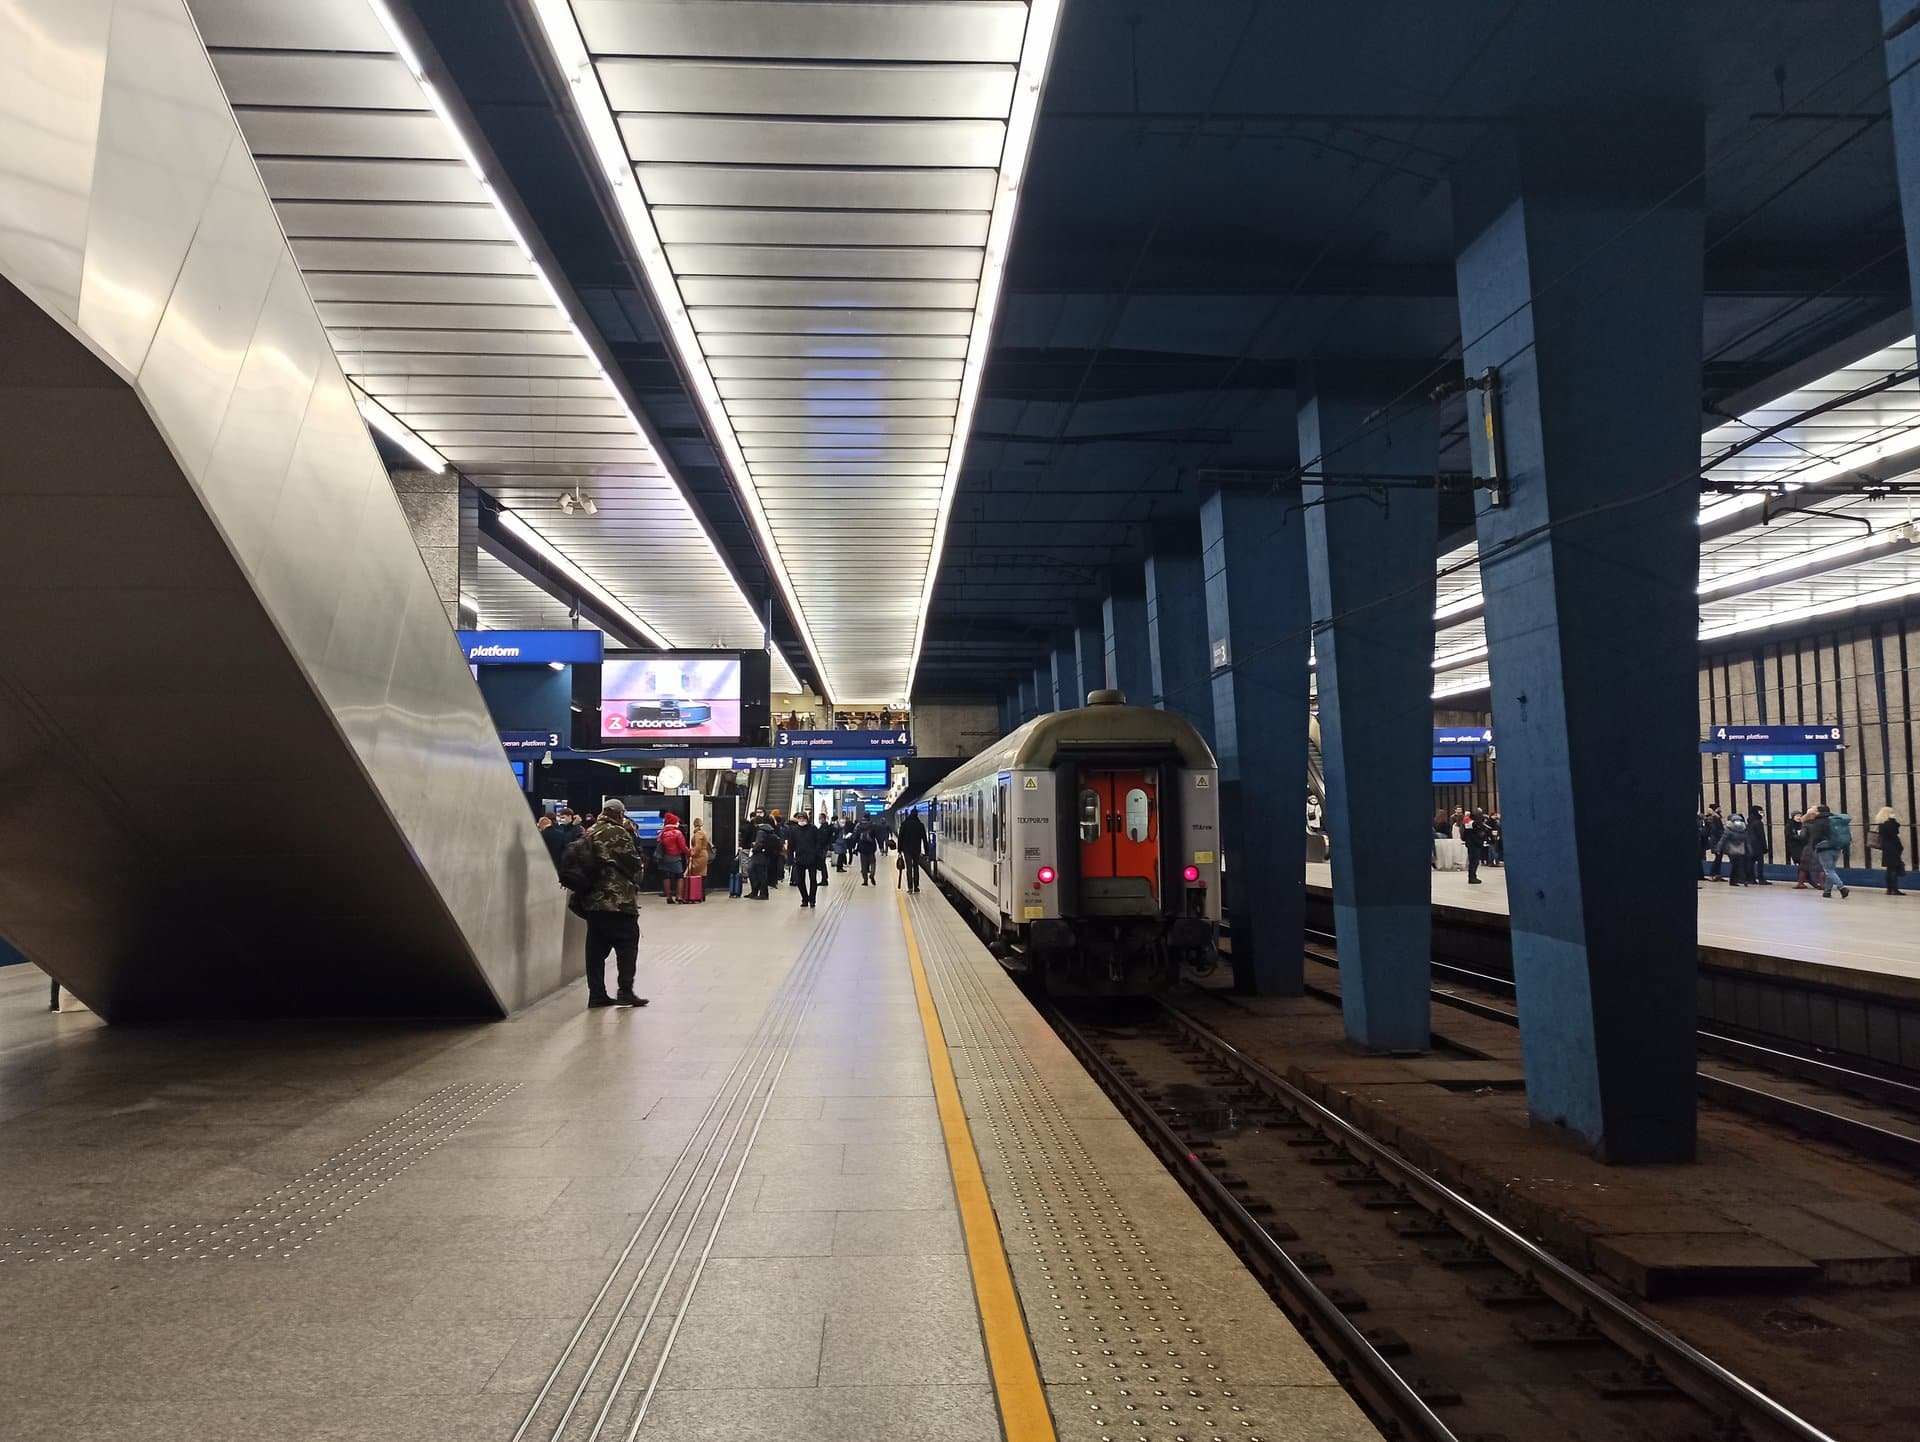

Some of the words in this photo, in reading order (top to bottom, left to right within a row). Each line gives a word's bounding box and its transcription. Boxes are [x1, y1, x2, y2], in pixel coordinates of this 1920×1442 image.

[470, 645, 519, 658] platform
[630, 719, 687, 728] roborock
[549, 734, 558, 746] 3
[779, 733, 789, 745] 3
[809, 738, 833, 746] platform
[897, 732, 907, 744] 4
[1482, 730, 1492, 742] 4
[1717, 728, 1727, 740] 4
[1831, 728, 1841, 740] 8
